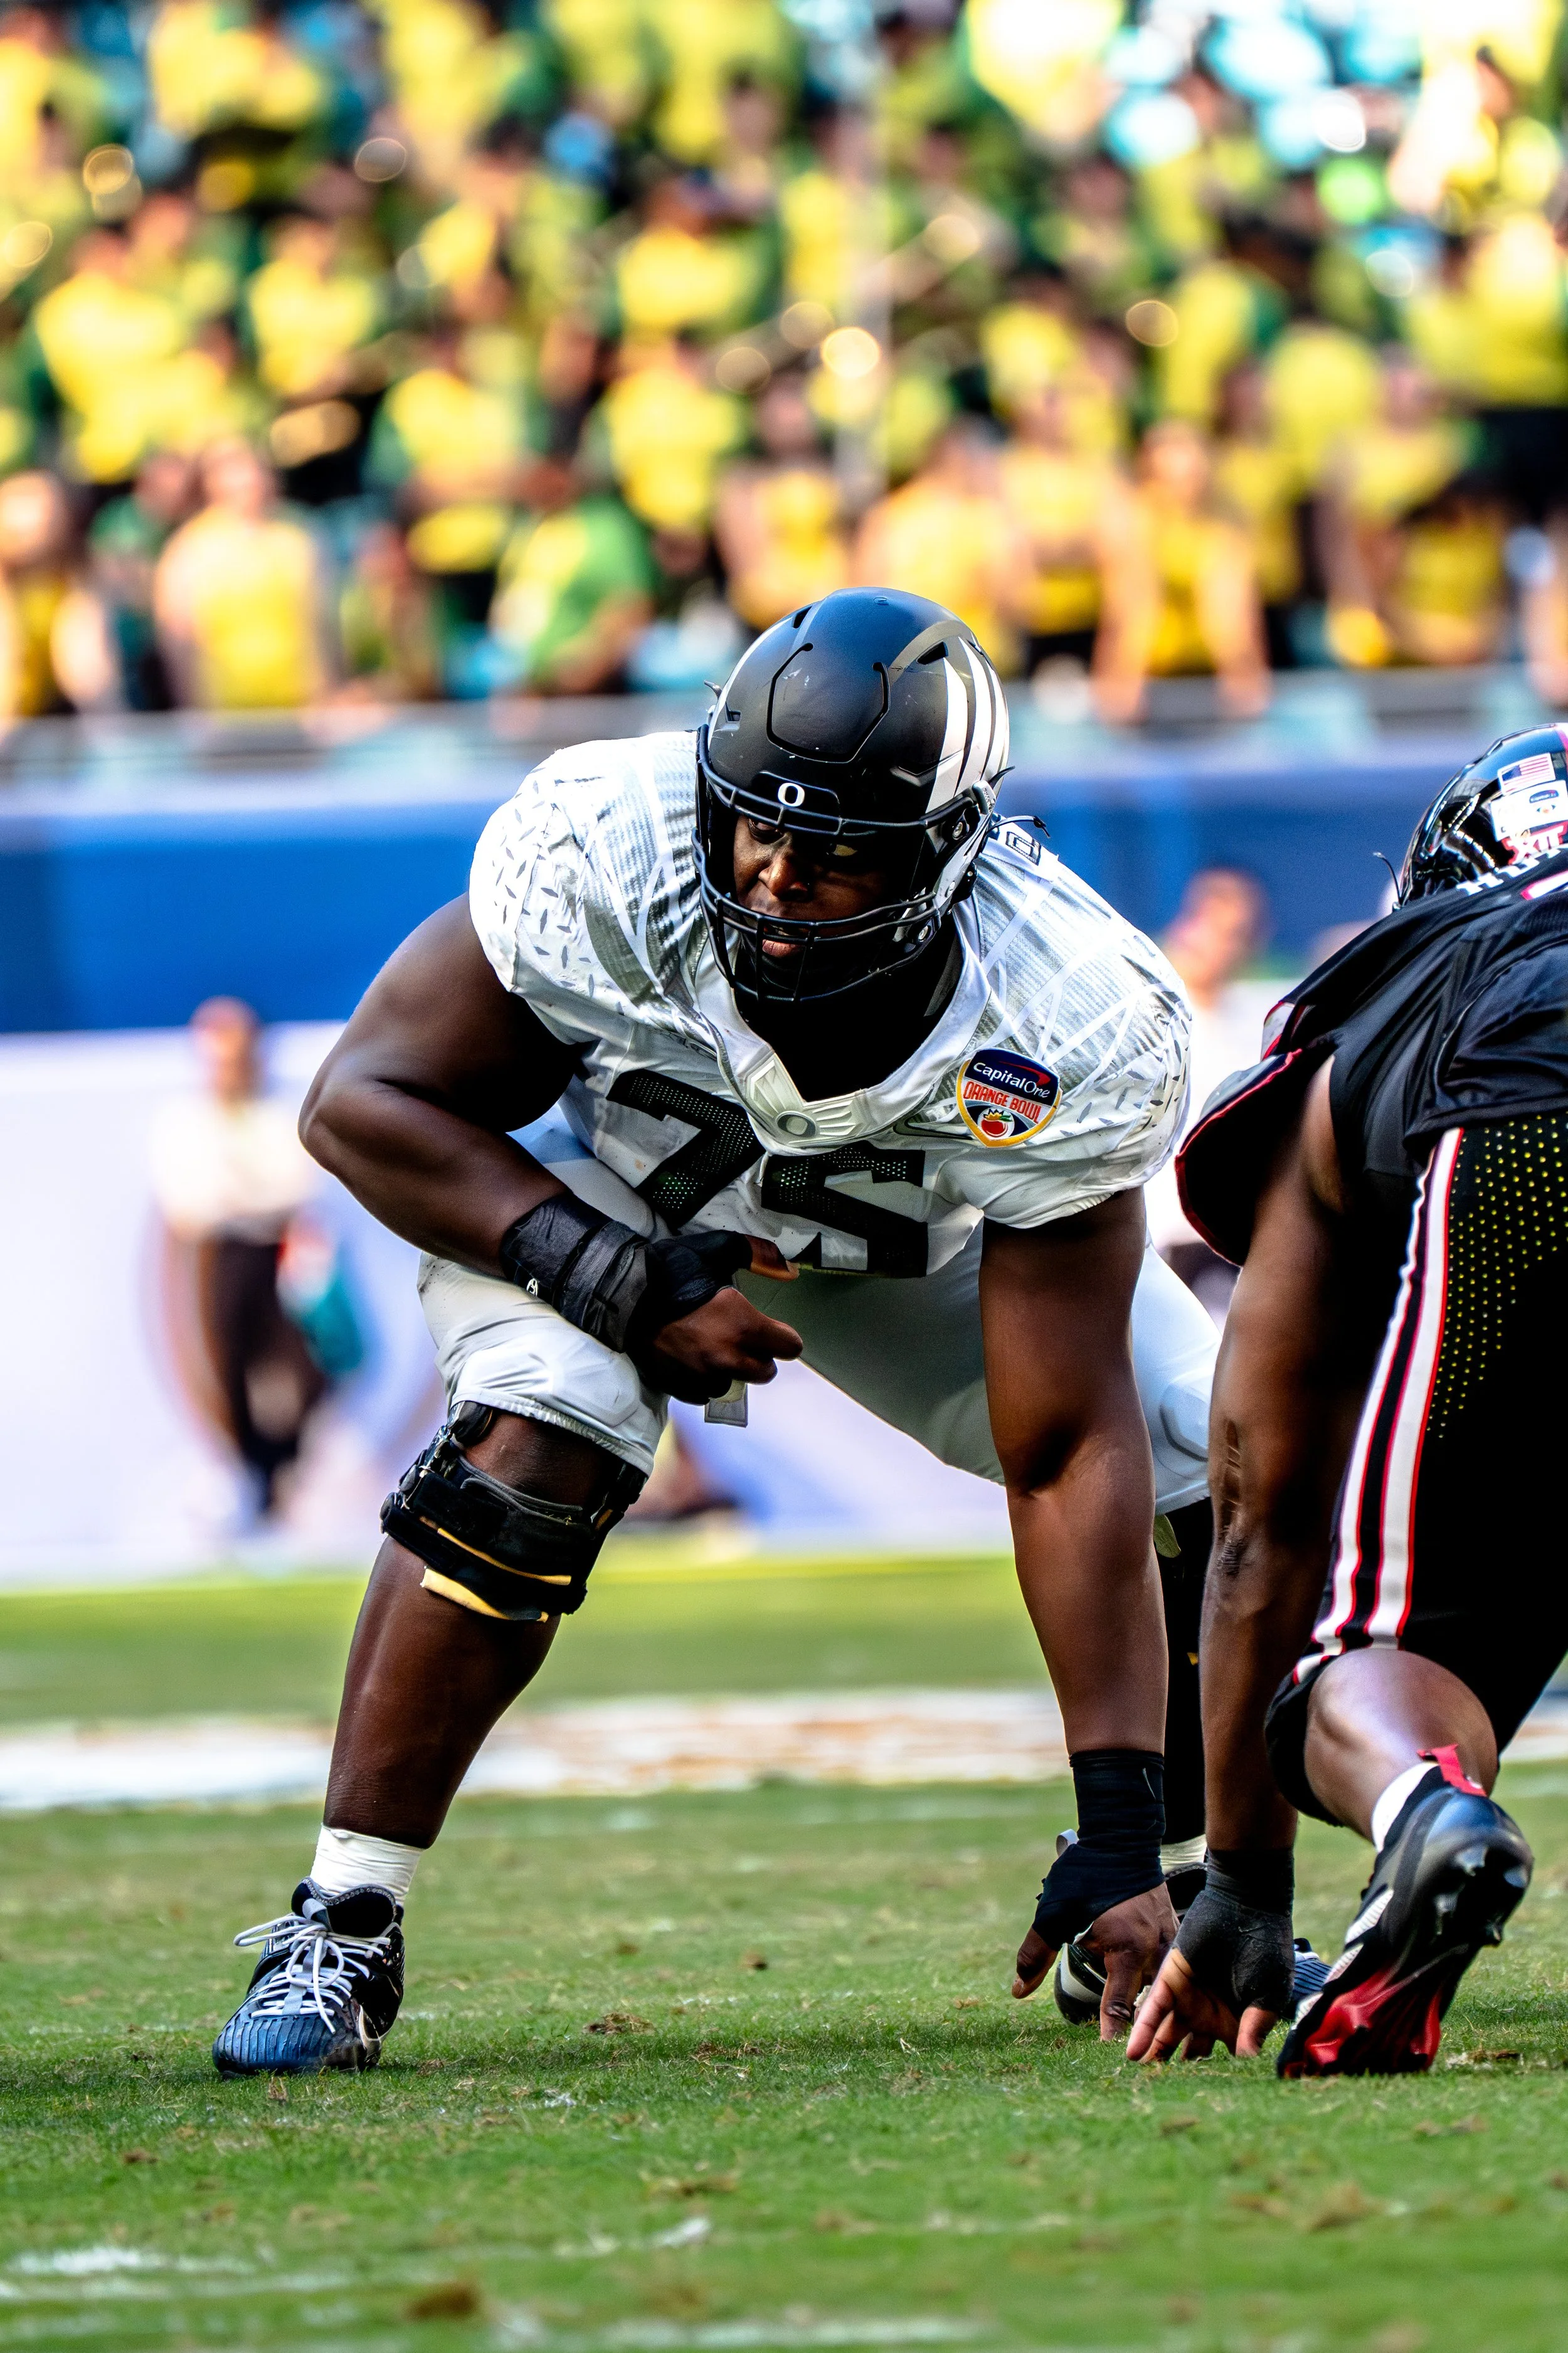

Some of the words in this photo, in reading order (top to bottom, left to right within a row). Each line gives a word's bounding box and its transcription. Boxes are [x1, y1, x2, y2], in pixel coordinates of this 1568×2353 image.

[778, 782, 805, 807] O
[963, 1081, 1010, 1107] ORANGE
[1009, 1097, 1042, 1124] BOWL
[606, 1069, 929, 1278] 75
